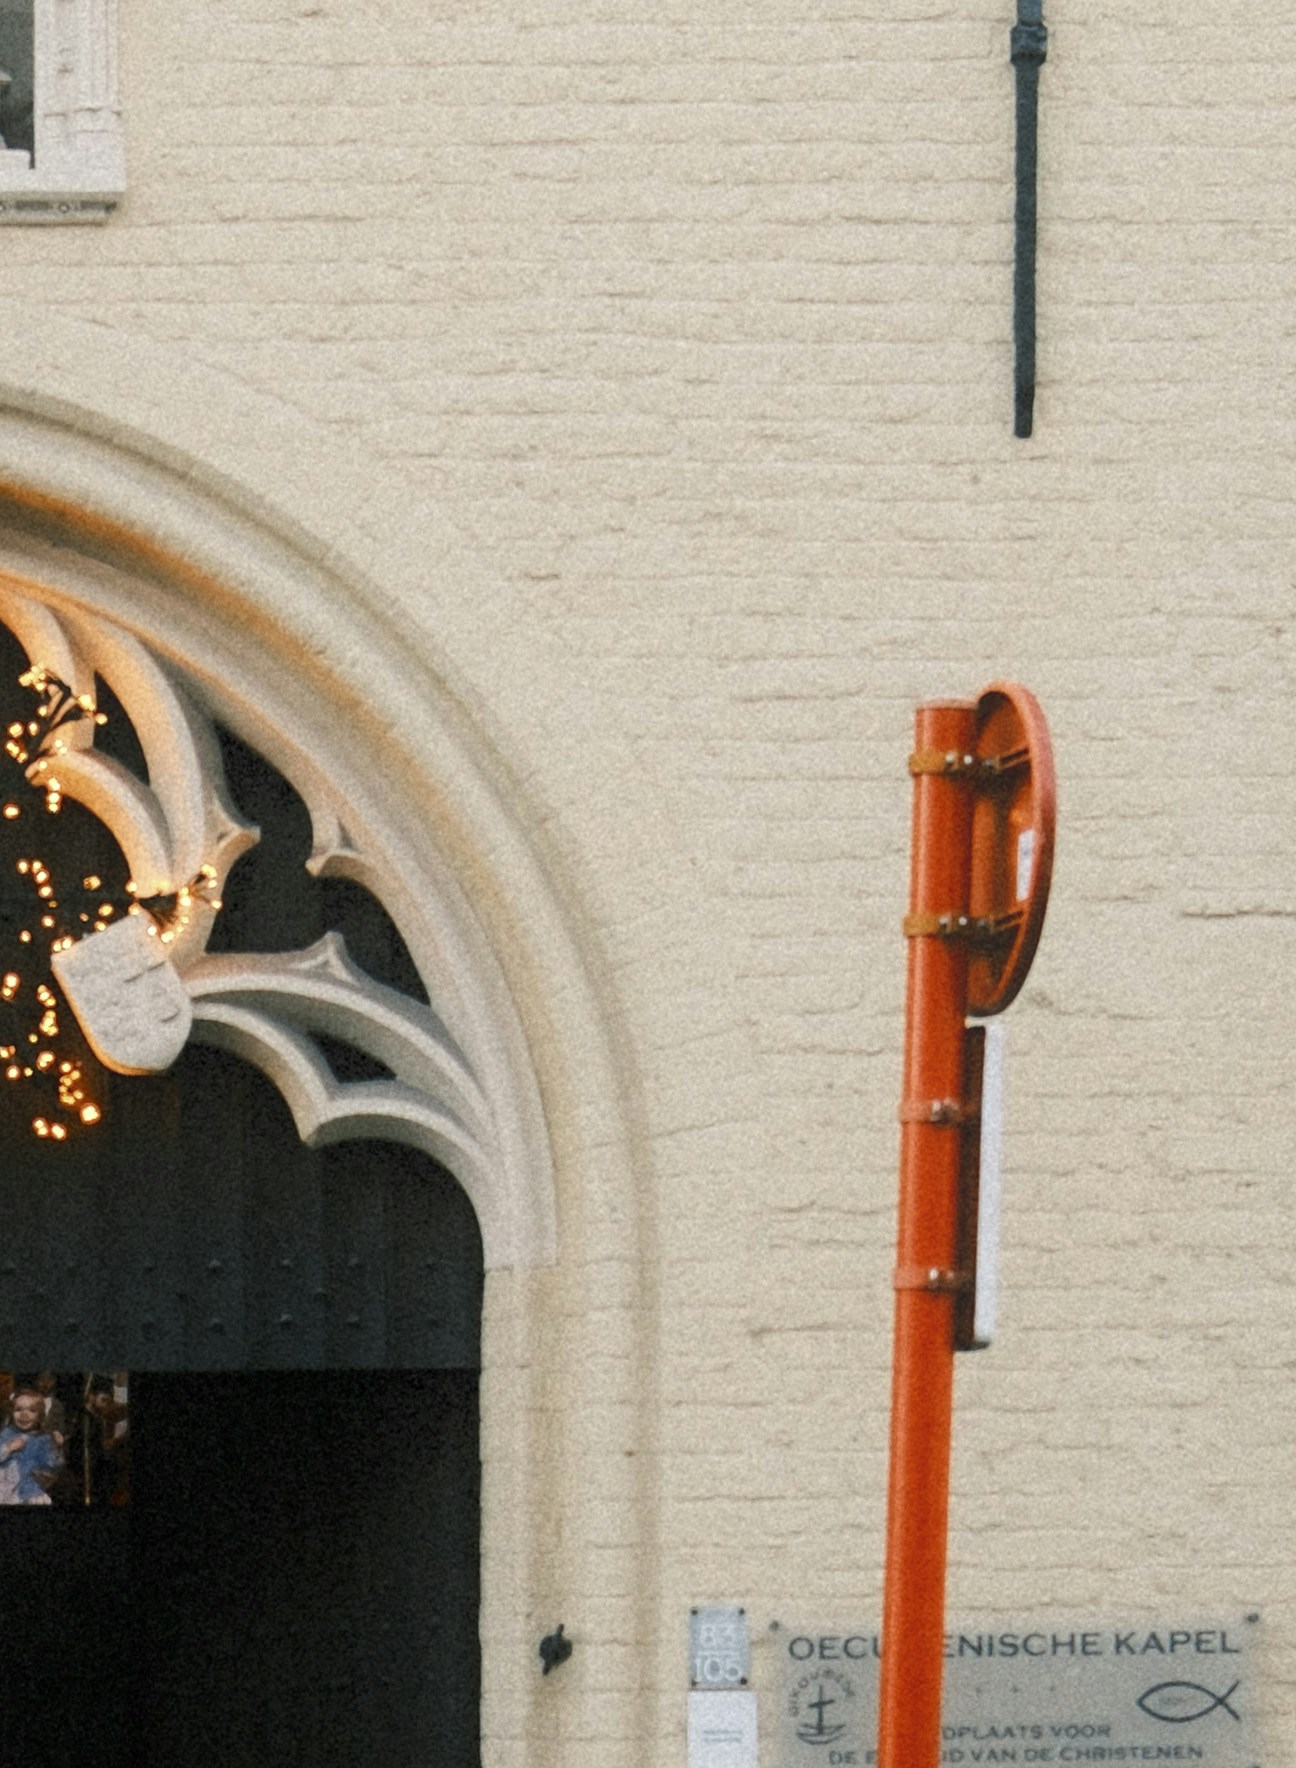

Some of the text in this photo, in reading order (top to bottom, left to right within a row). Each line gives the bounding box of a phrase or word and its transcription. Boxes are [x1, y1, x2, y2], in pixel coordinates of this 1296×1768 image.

[1115, 1630, 1240, 1656] KAPEL
[694, 1656, 743, 1682] 105
[1050, 1723, 1111, 1739] VOOR
[829, 1750, 857, 1766] DE
[971, 1747, 1017, 1764] VAN
[1024, 1747, 1053, 1763] DE
[1058, 1745, 1204, 1762] CHRISTENEN
